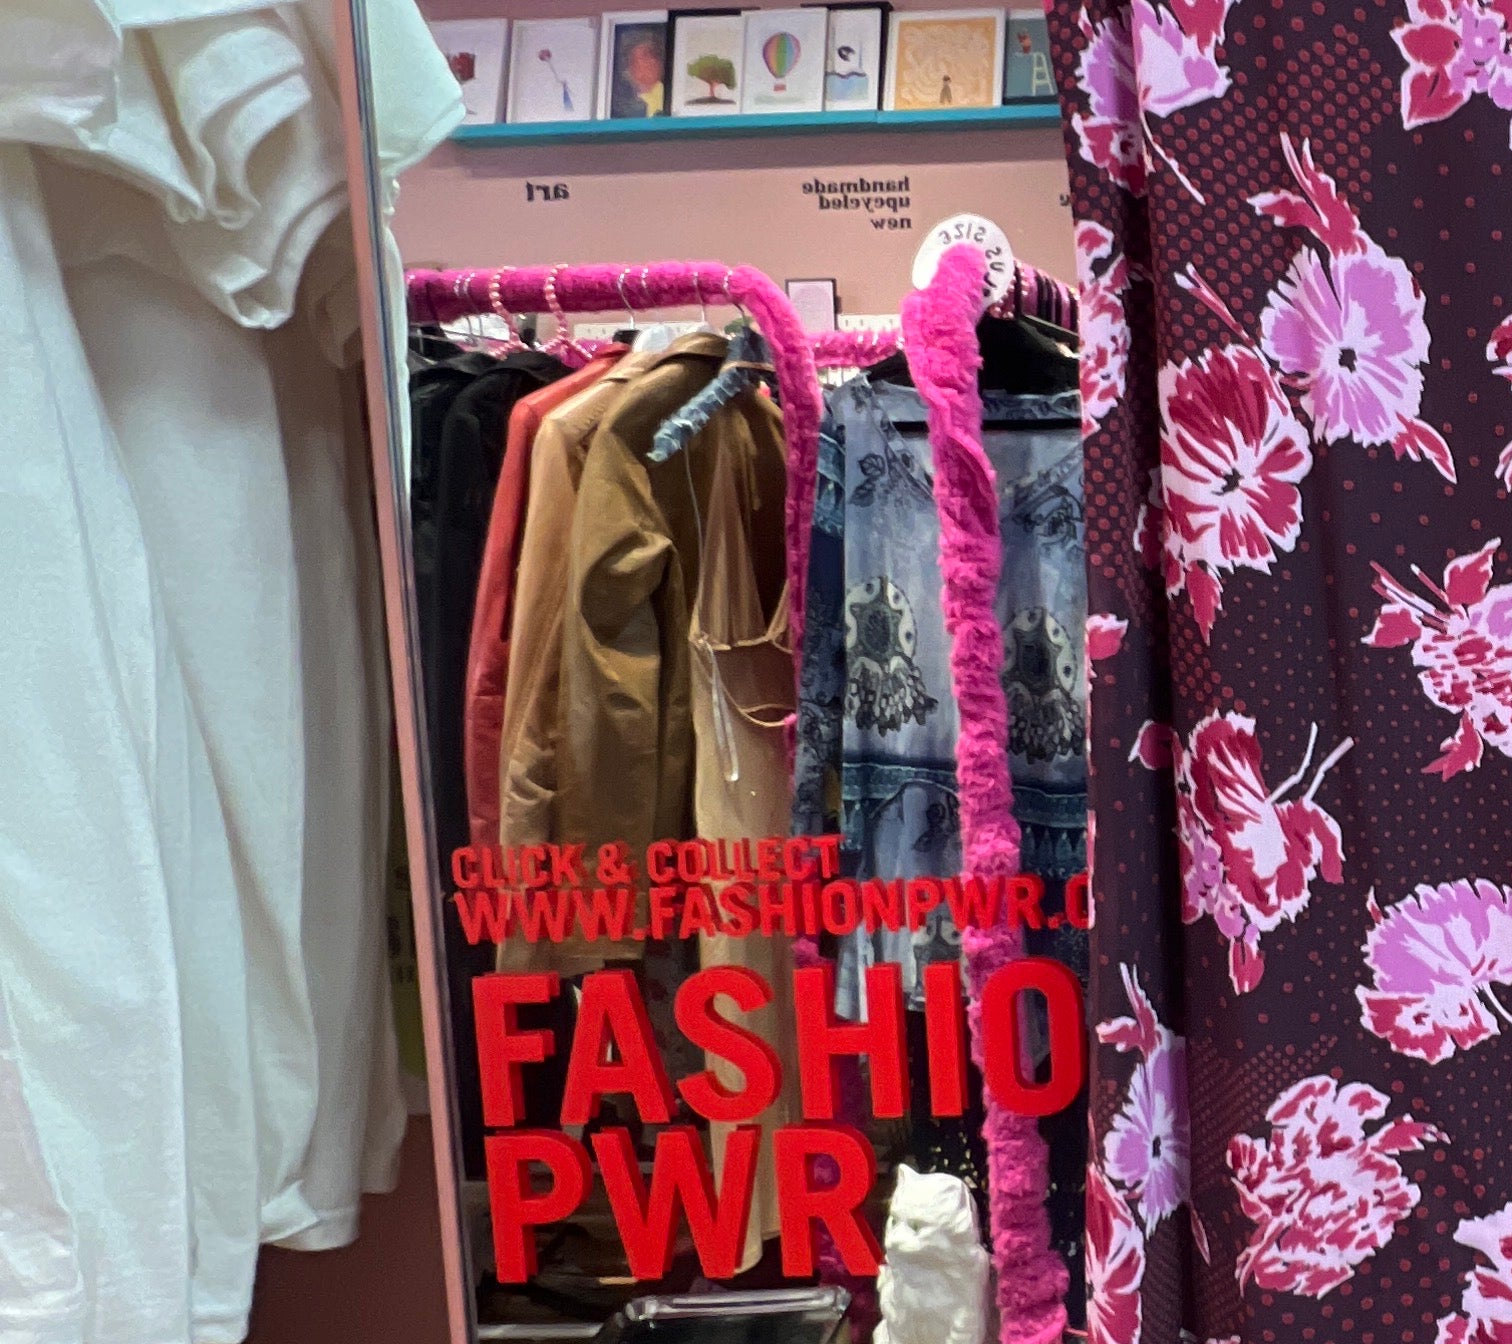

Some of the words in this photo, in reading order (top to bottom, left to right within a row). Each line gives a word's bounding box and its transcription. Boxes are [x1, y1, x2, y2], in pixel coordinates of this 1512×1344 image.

[452, 842, 585, 888] CLICK
[597, 840, 635, 885] &
[647, 836, 842, 884] COLLECT
[484, 1126, 884, 1283] PWR
